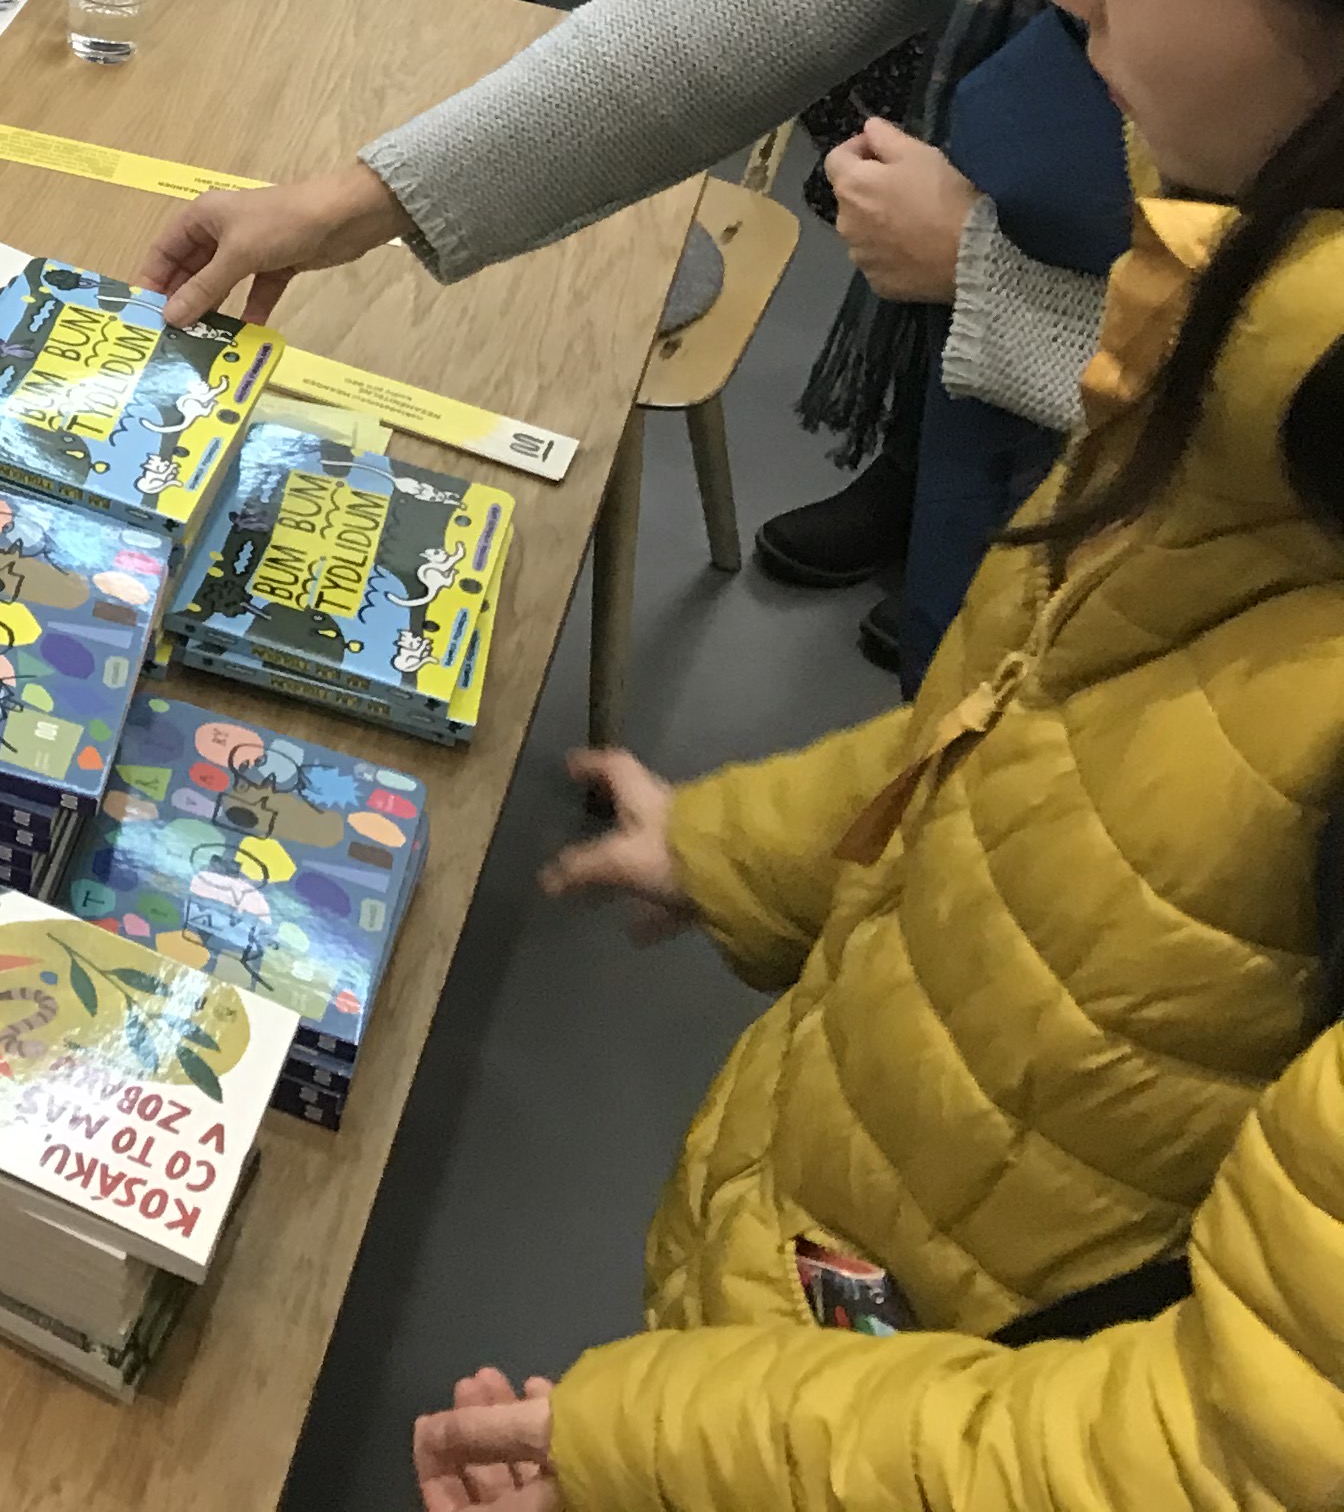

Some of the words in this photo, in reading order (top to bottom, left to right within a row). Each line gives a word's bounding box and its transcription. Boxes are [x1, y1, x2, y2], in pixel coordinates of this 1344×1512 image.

[42, 305, 106, 362] BUM
[65, 324, 161, 436] TYDLIDUM
[276, 472, 333, 535] BUM
[251, 543, 309, 603] BUM
[313, 489, 391, 614] TYDLIDUM
[110, 1124, 155, 1168] TO
[196, 1122, 227, 1156] V
[39, 1133, 202, 1238] KOSÁKU,
[165, 1150, 218, 1194] CO
